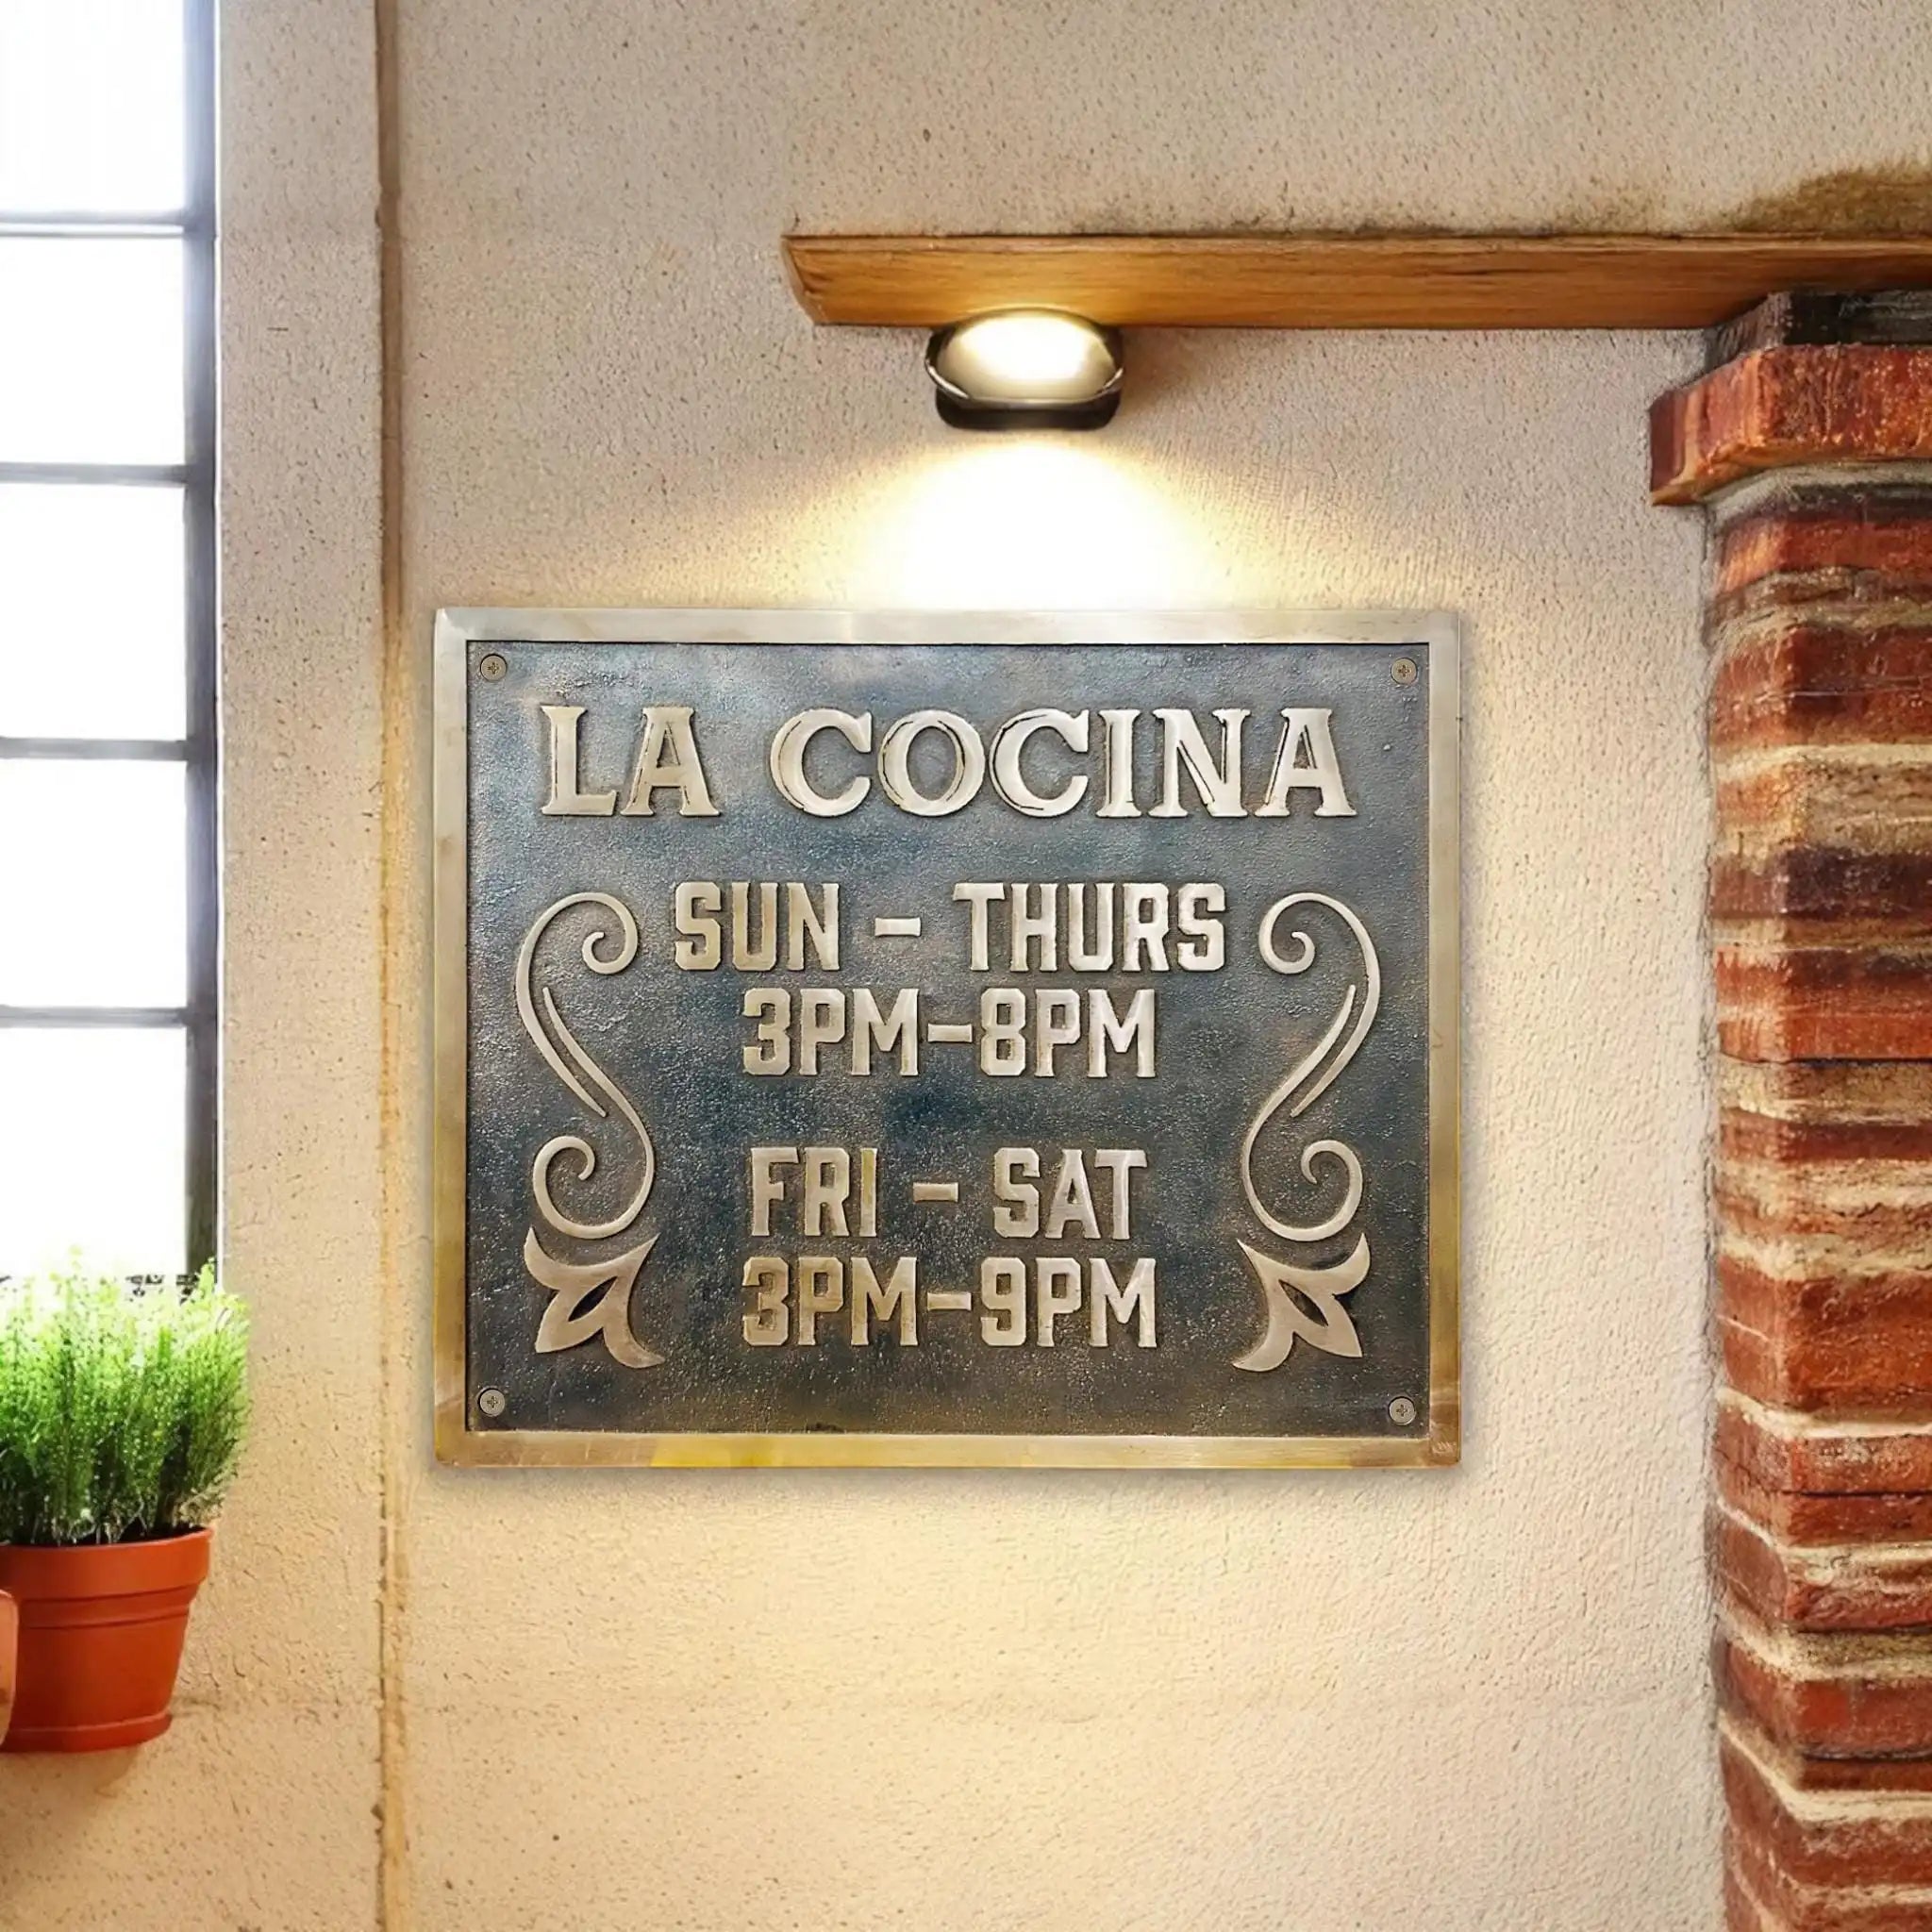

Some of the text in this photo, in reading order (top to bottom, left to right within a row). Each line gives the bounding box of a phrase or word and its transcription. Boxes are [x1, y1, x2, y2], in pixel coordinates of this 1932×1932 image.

[541, 706, 1358, 817] LA COCINA
[675, 881, 841, 972] SUN
[952, 882, 1226, 972] THURS
[750, 1146, 878, 1238] FRI
[992, 1146, 1148, 1241] SAT
